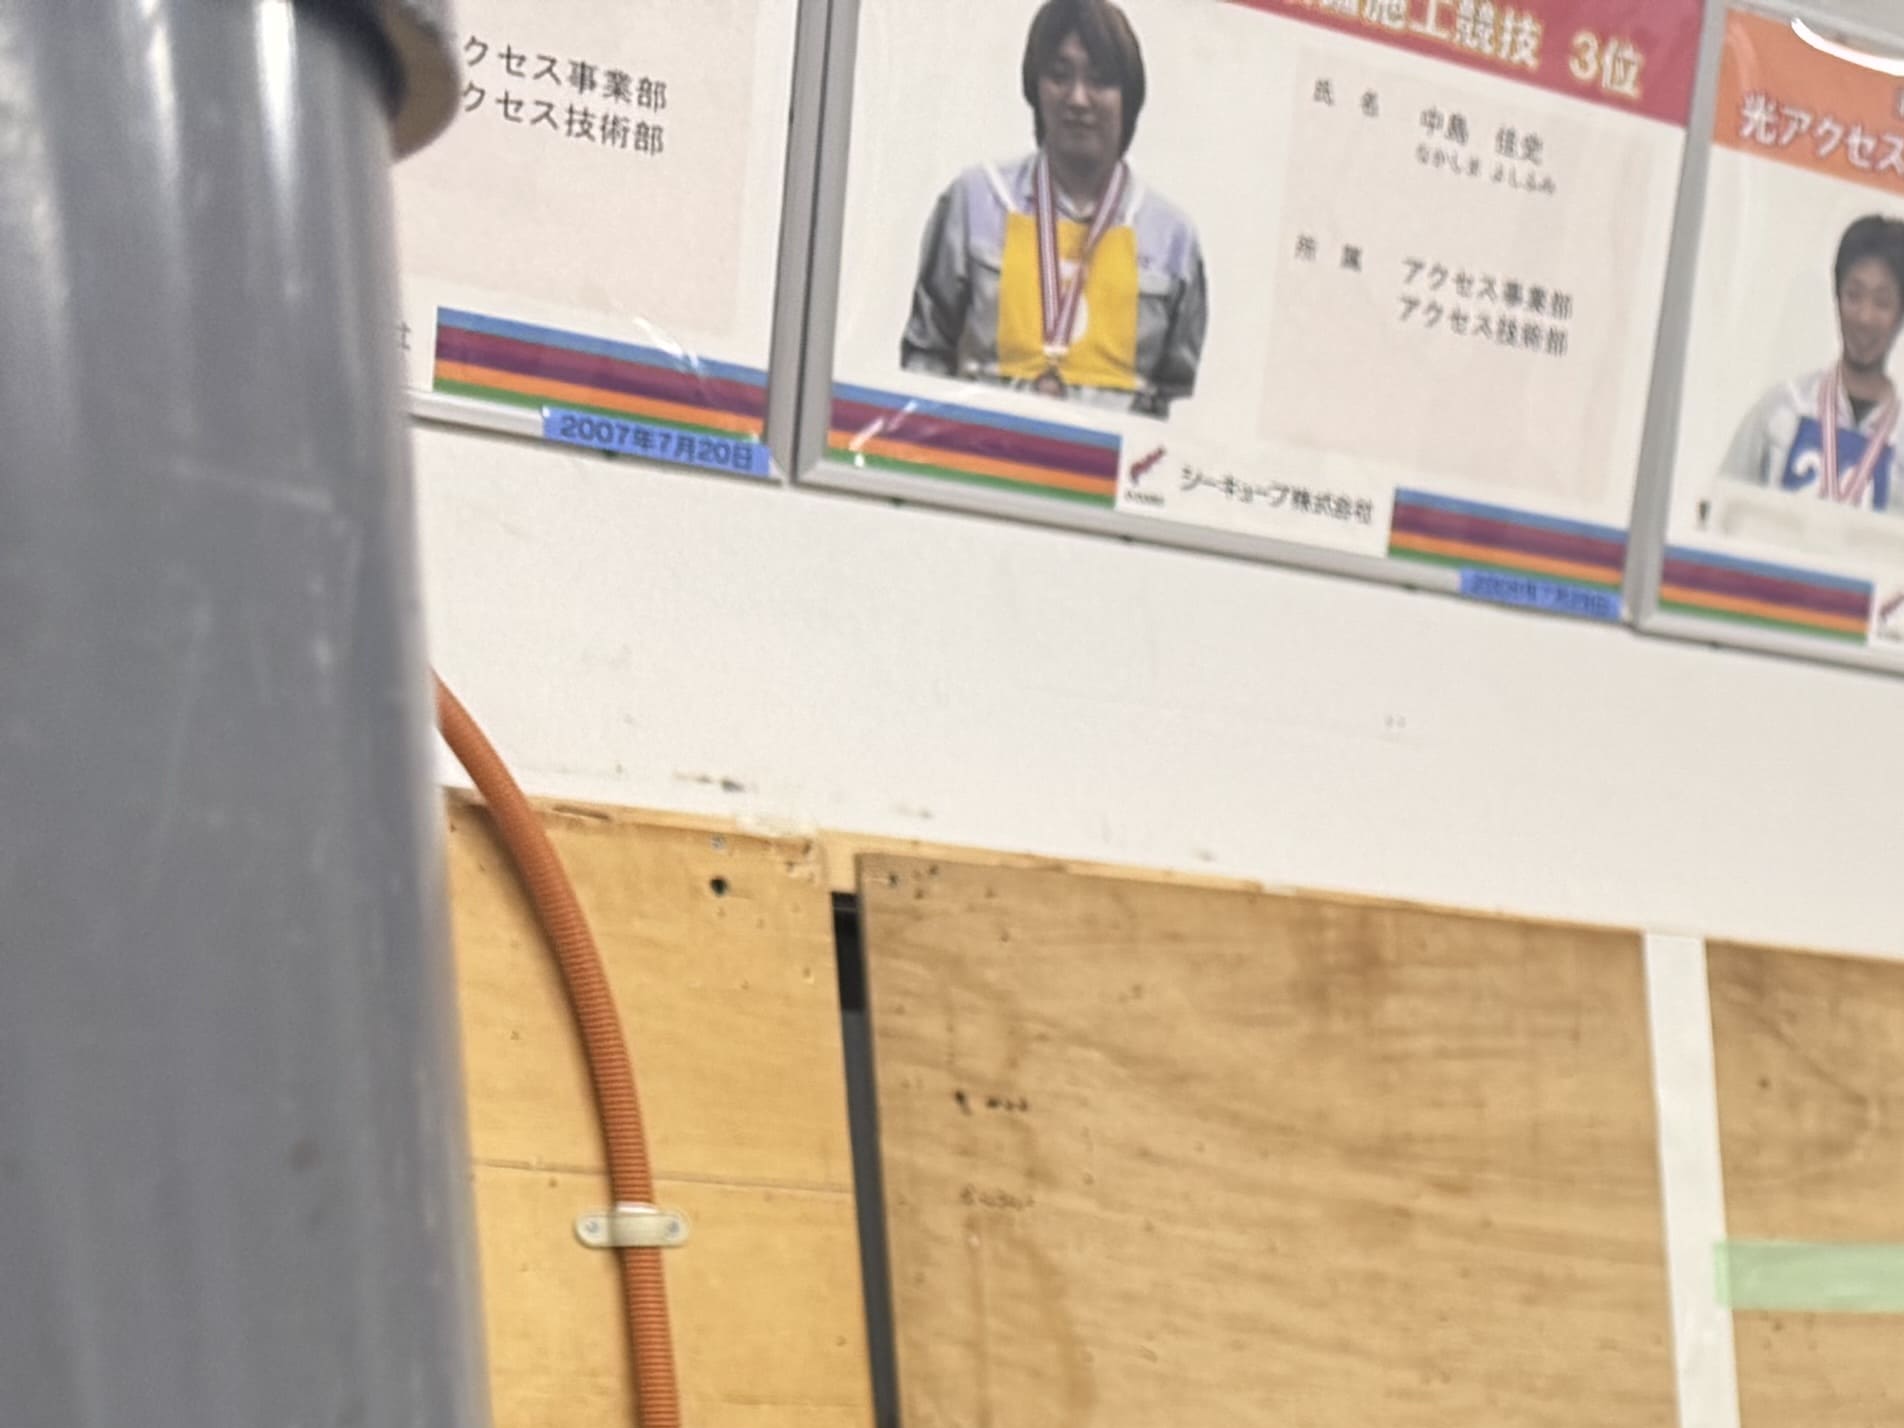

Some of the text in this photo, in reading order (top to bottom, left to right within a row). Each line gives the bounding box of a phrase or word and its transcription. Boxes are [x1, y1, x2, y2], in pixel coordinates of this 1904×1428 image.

[1568, 32, 1641, 98] 3位
[559, 414, 752, 470] 2007年7月20日
